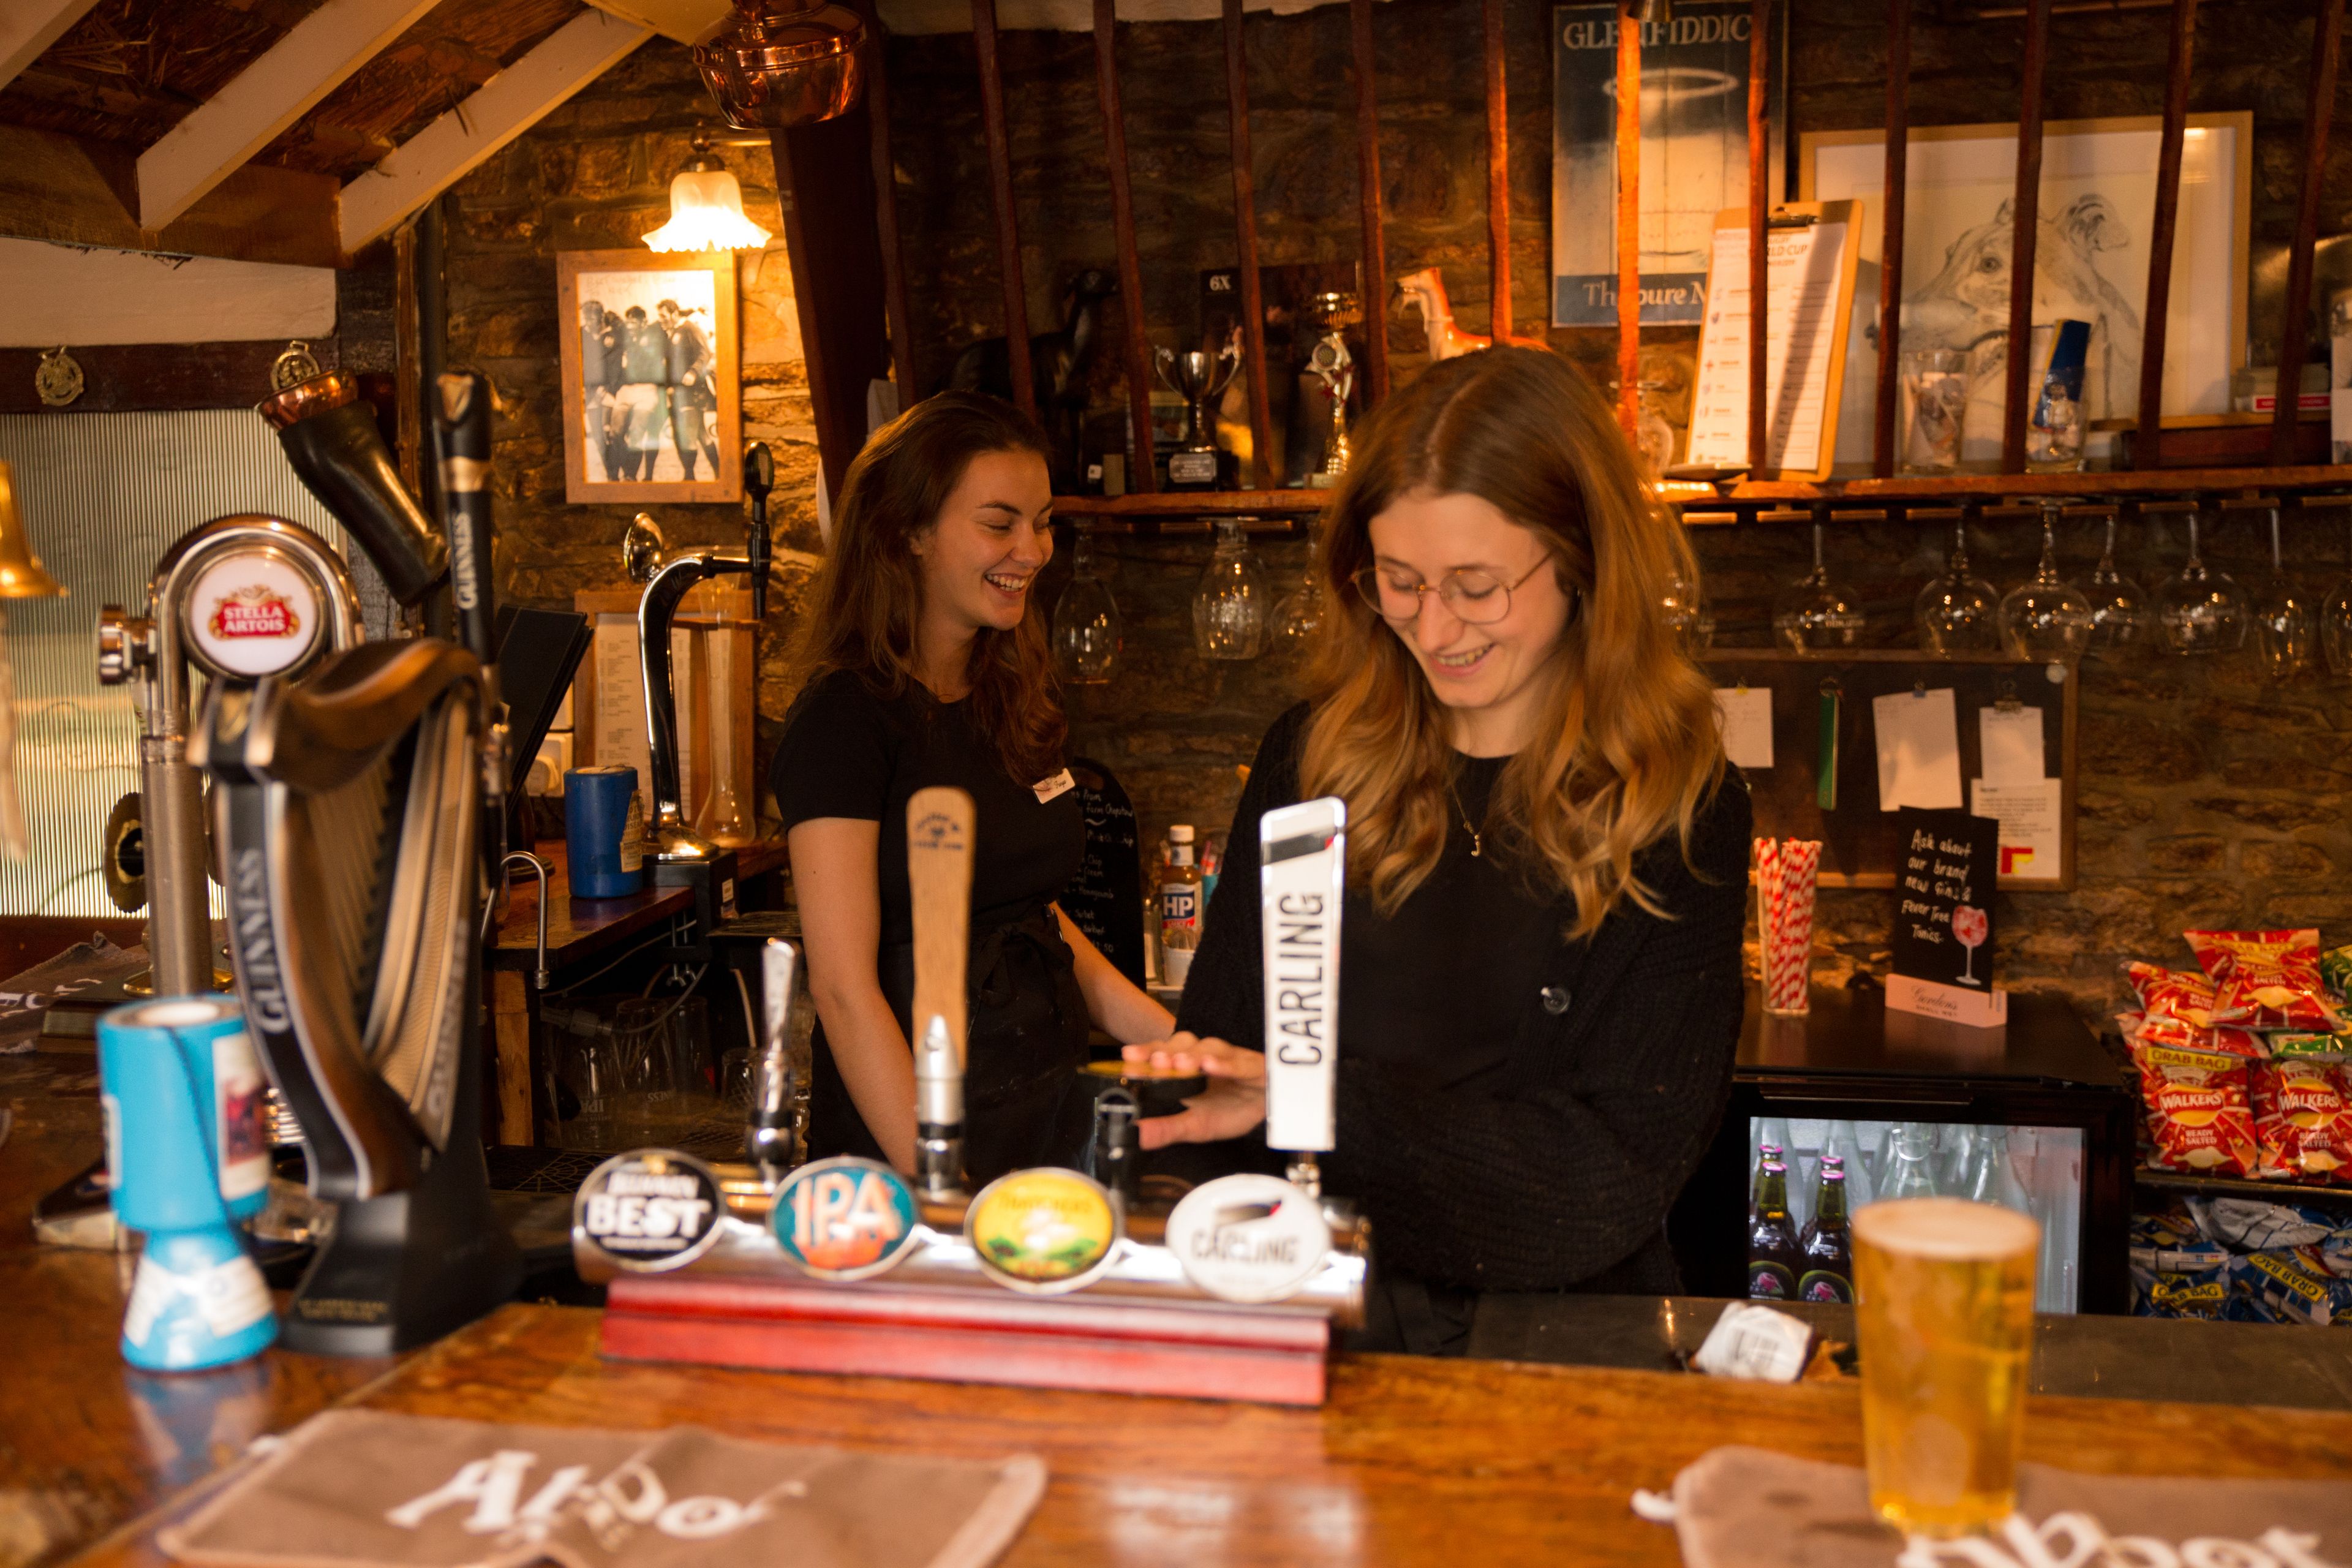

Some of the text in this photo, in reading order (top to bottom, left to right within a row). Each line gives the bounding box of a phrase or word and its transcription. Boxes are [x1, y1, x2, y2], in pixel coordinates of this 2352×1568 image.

[1563, 14, 1751, 50] GLEFIDDIC
[1209, 274, 1232, 291] 6X
[1582, 280, 1618, 307] Th
[454, 511, 478, 610] GUINNESS
[223, 605, 284, 620] STELLA
[224, 618, 285, 633] ARTOIS
[1911, 829, 1972, 858] Ask about
[1908, 856, 1970, 886] our brand
[1905, 875, 1929, 894] new
[1164, 896, 1194, 918] HP
[1930, 905, 1950, 923] Tree
[236, 848, 291, 1035] GUINNESS
[1278, 894, 1323, 1066] CARLING
[2152, 1047, 2226, 1070] GRAB BAG
[2160, 1092, 2223, 1109] WALKERS
[2279, 1092, 2340, 1111] WALKERS
[2184, 1136, 2218, 1146] SALTED
[2185, 1128, 2214, 1138] READY
[586, 1194, 712, 1238] BEST
[795, 1171, 902, 1247] IPA
[1191, 1227, 1300, 1266] CARLING
[2255, 1254, 2318, 1297] GRAB BAG
